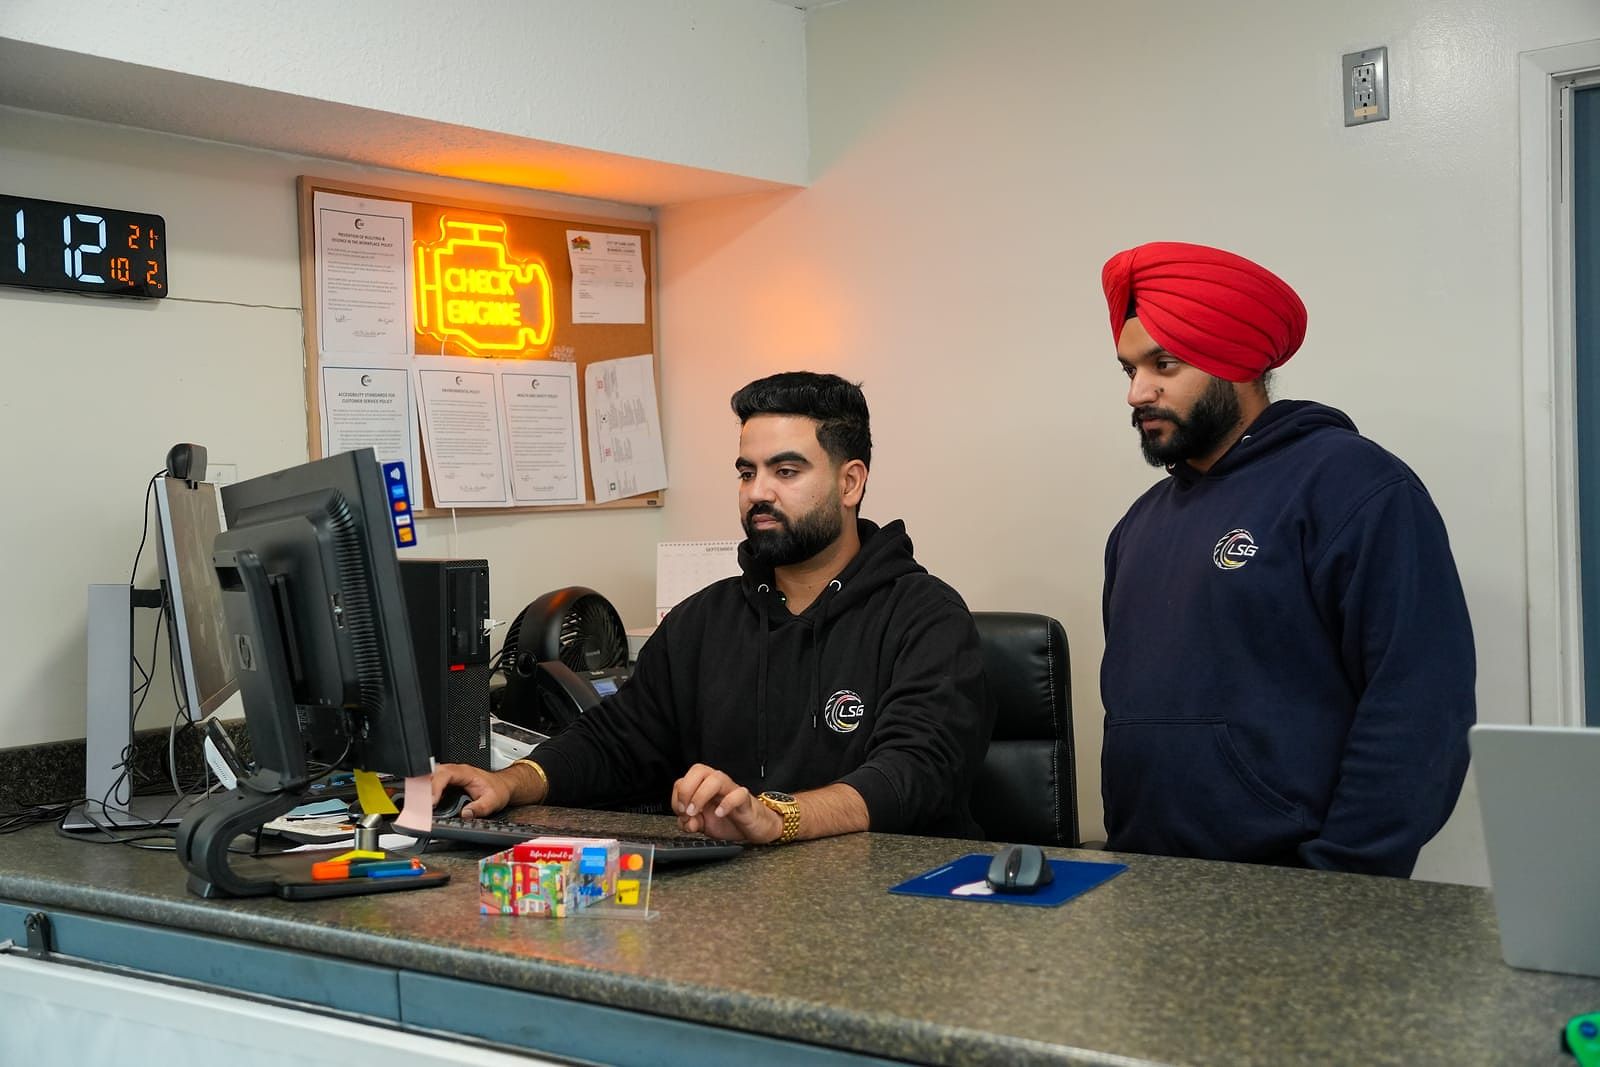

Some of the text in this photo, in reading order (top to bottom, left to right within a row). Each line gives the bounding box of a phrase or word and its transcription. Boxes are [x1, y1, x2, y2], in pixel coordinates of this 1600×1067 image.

[63, 213, 106, 284] 12
[128, 224, 154, 249] 21
[111, 257, 130, 282] 10
[146, 260, 158, 285] 2
[445, 267, 515, 296] CHECK
[447, 299, 522, 327] ENGINE
[1227, 543, 1259, 557] LSG
[838, 704, 865, 718] LSG
